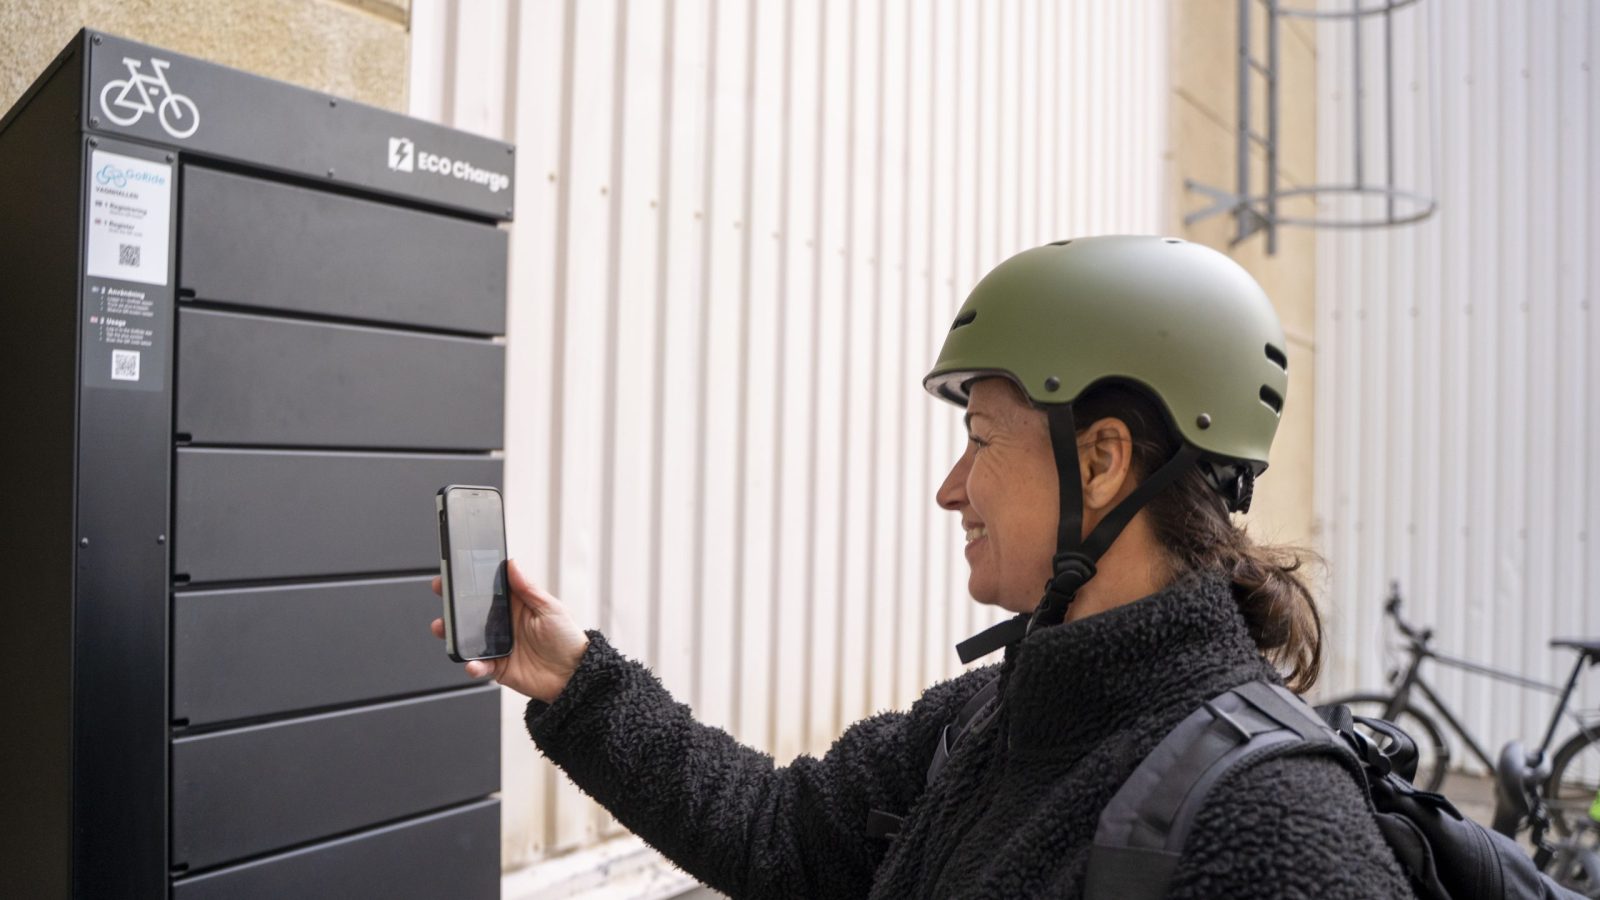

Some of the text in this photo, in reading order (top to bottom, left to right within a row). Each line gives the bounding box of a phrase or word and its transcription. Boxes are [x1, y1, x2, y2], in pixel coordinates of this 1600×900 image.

[126, 169, 166, 186] GoRide
[418, 151, 509, 193] ECO Charge
[109, 220, 135, 231] Register
[106, 317, 126, 328] Usage
